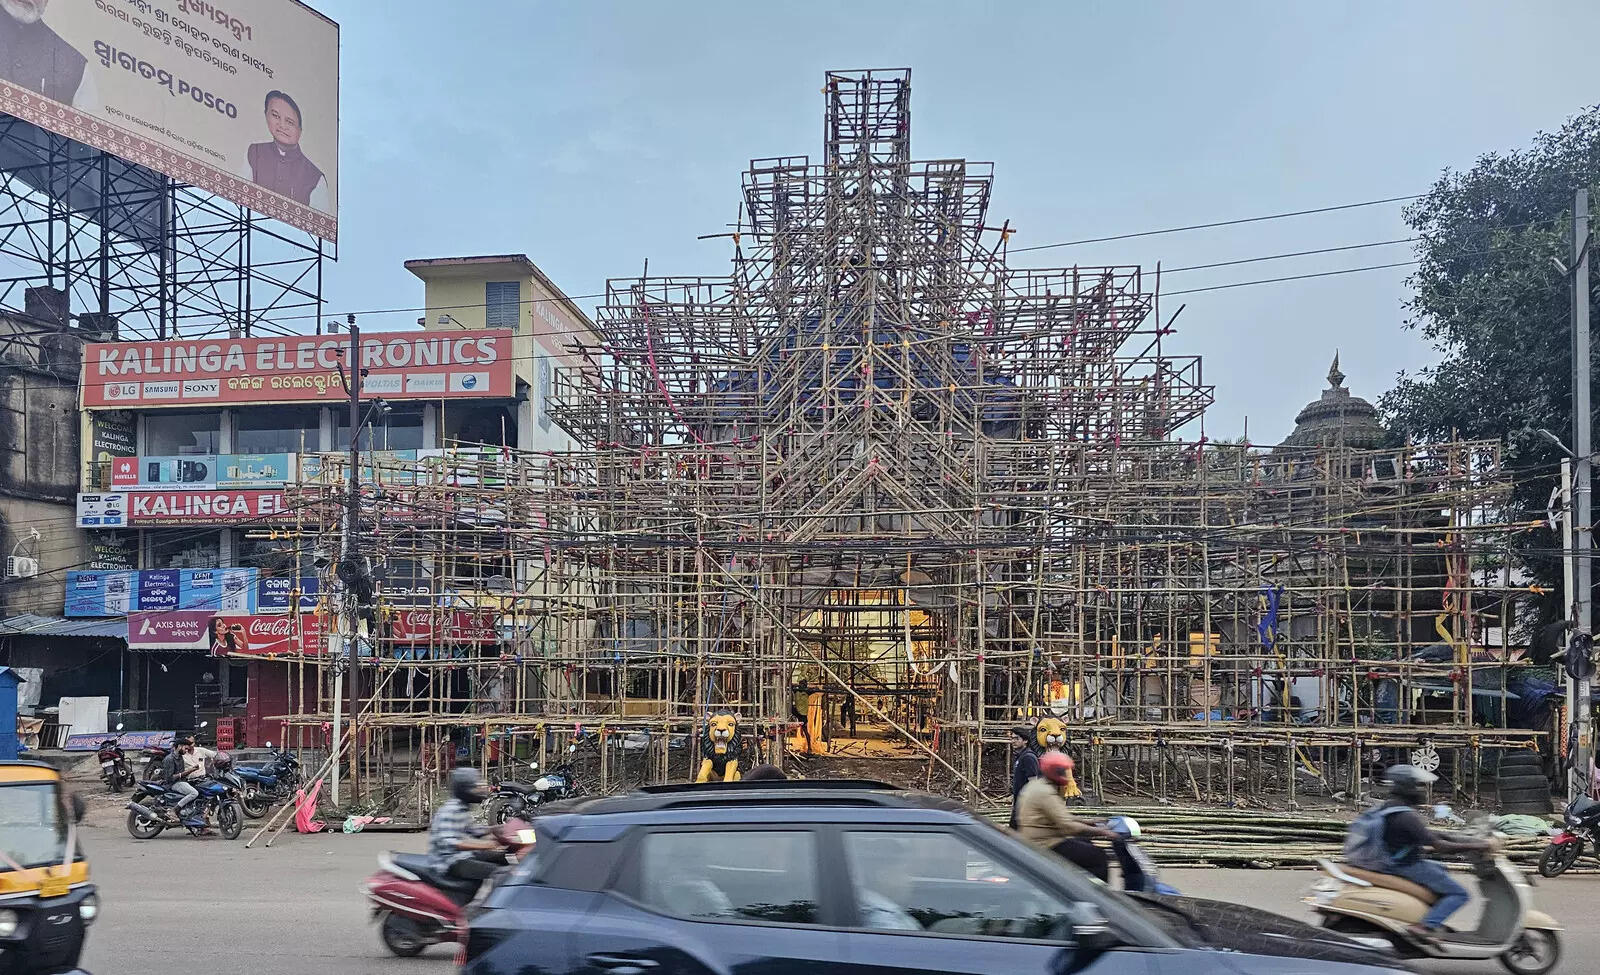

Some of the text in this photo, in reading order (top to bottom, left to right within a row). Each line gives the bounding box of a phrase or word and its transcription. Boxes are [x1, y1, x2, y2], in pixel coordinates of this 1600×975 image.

[178, 79, 238, 119] POSCO
[99, 336, 498, 376] KALINGA ELECTRONICS
[122, 385, 136, 396] LG
[144, 385, 178, 394] SAMSUNG
[184, 384, 218, 393] SONY
[101, 431, 129, 443] KALINGA
[94, 440, 136, 454] ELECTRONICS
[133, 494, 250, 516] KALINGA
[90, 562, 133, 570] ELECTRONICS
[155, 620, 199, 629] AXIS BANK
